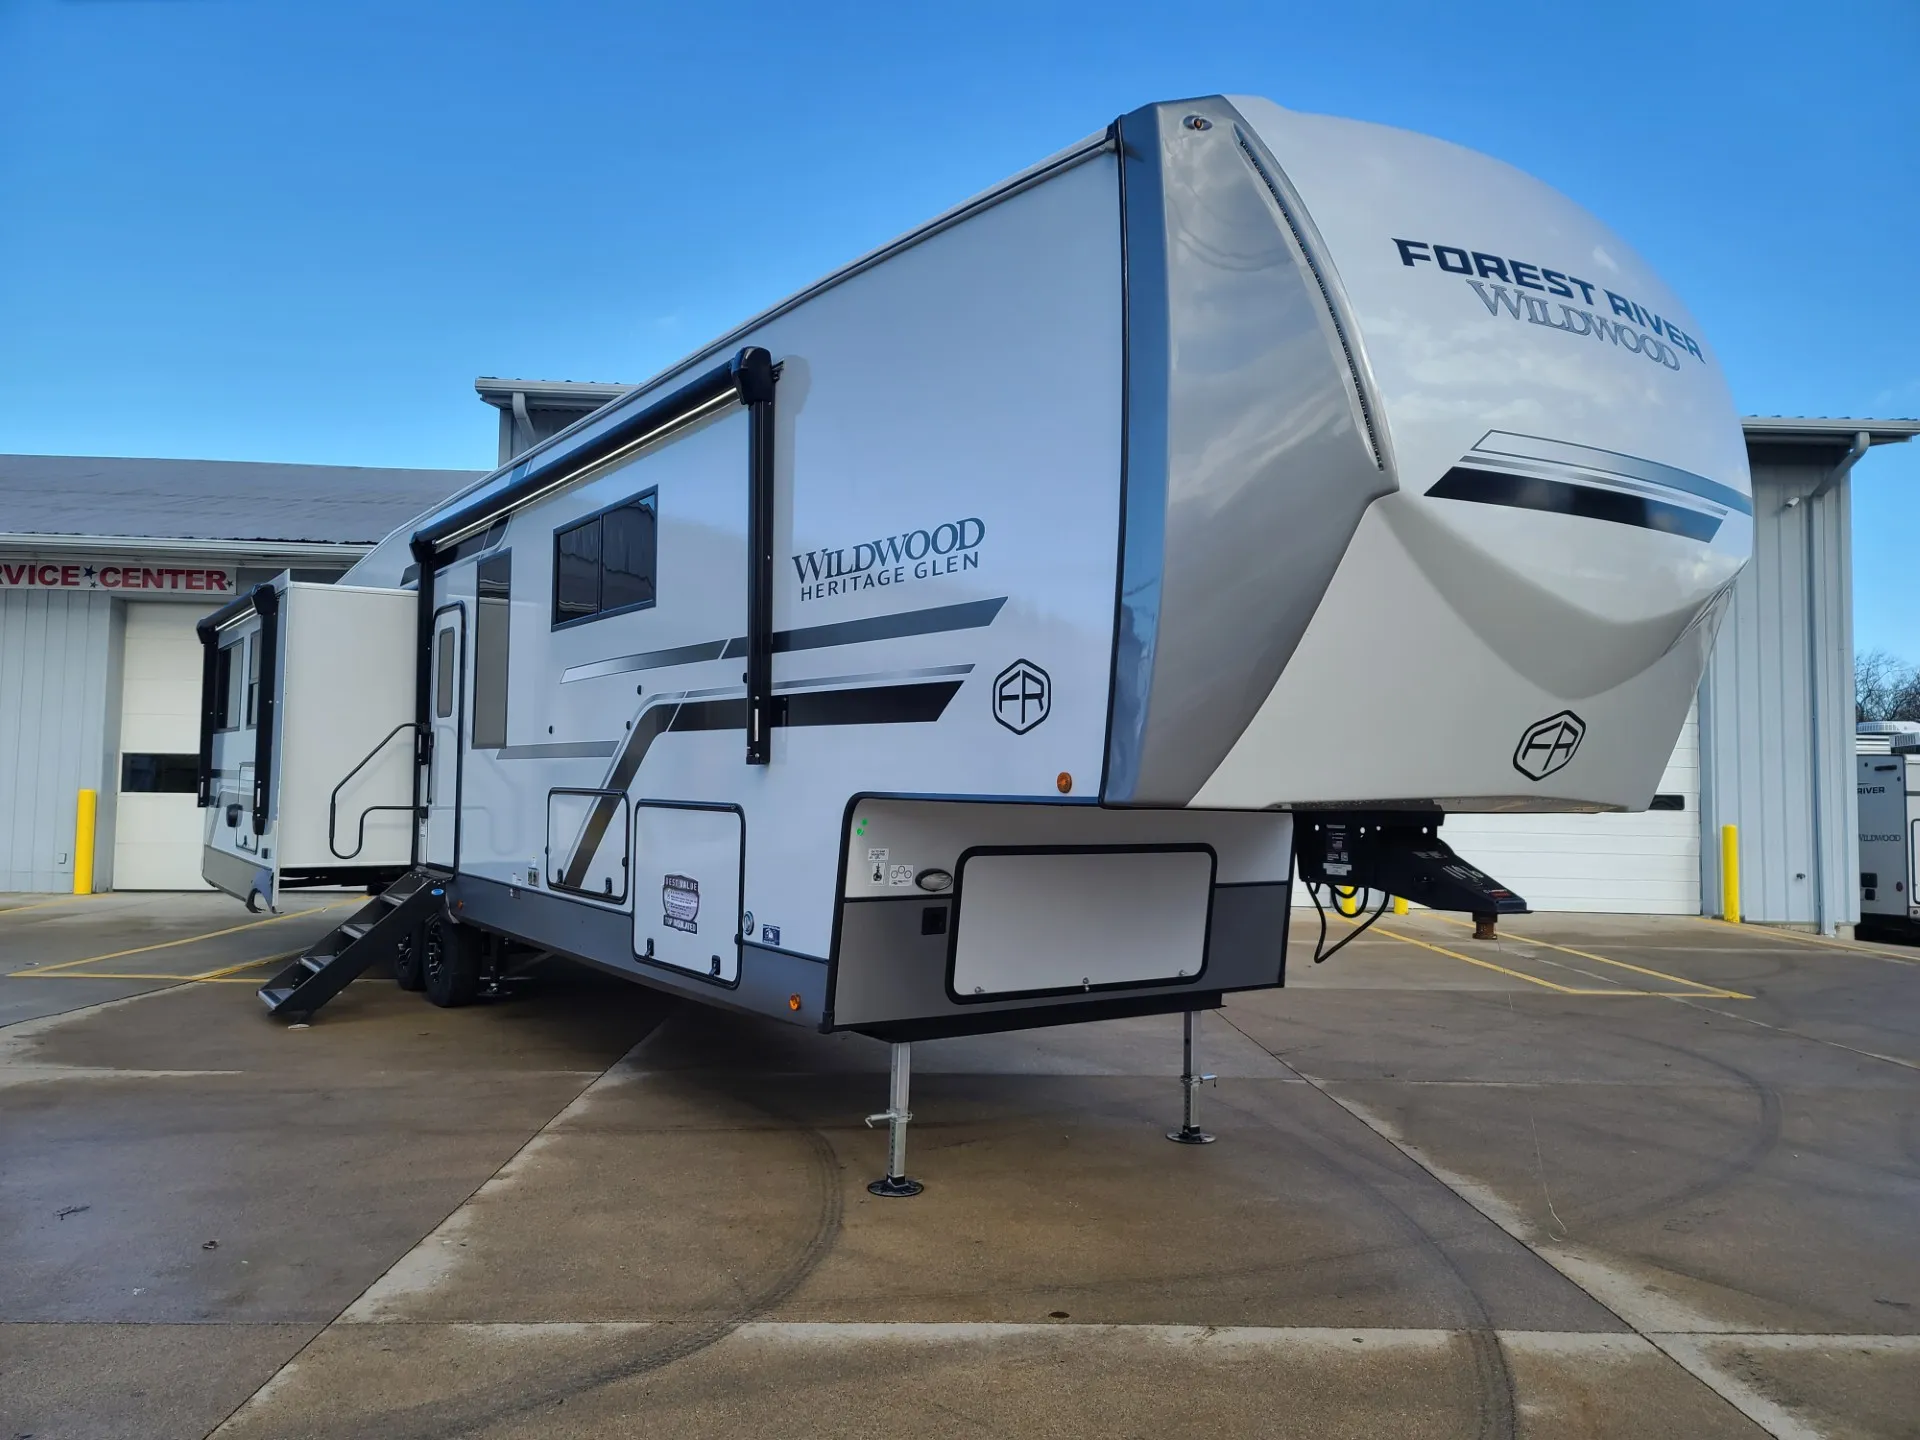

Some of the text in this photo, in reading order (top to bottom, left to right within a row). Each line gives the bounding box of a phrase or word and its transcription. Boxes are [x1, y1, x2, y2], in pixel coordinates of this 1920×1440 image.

[1390, 237, 1707, 365] FOREST RIVER
[1465, 278, 1681, 371] WILDWOOD
[0, 564, 227, 591] VICE CENTER
[791, 517, 986, 585] WILDWOOD
[800, 551, 979, 602] HERITAGE GLEN
[680, 880, 698, 891] VALUE
